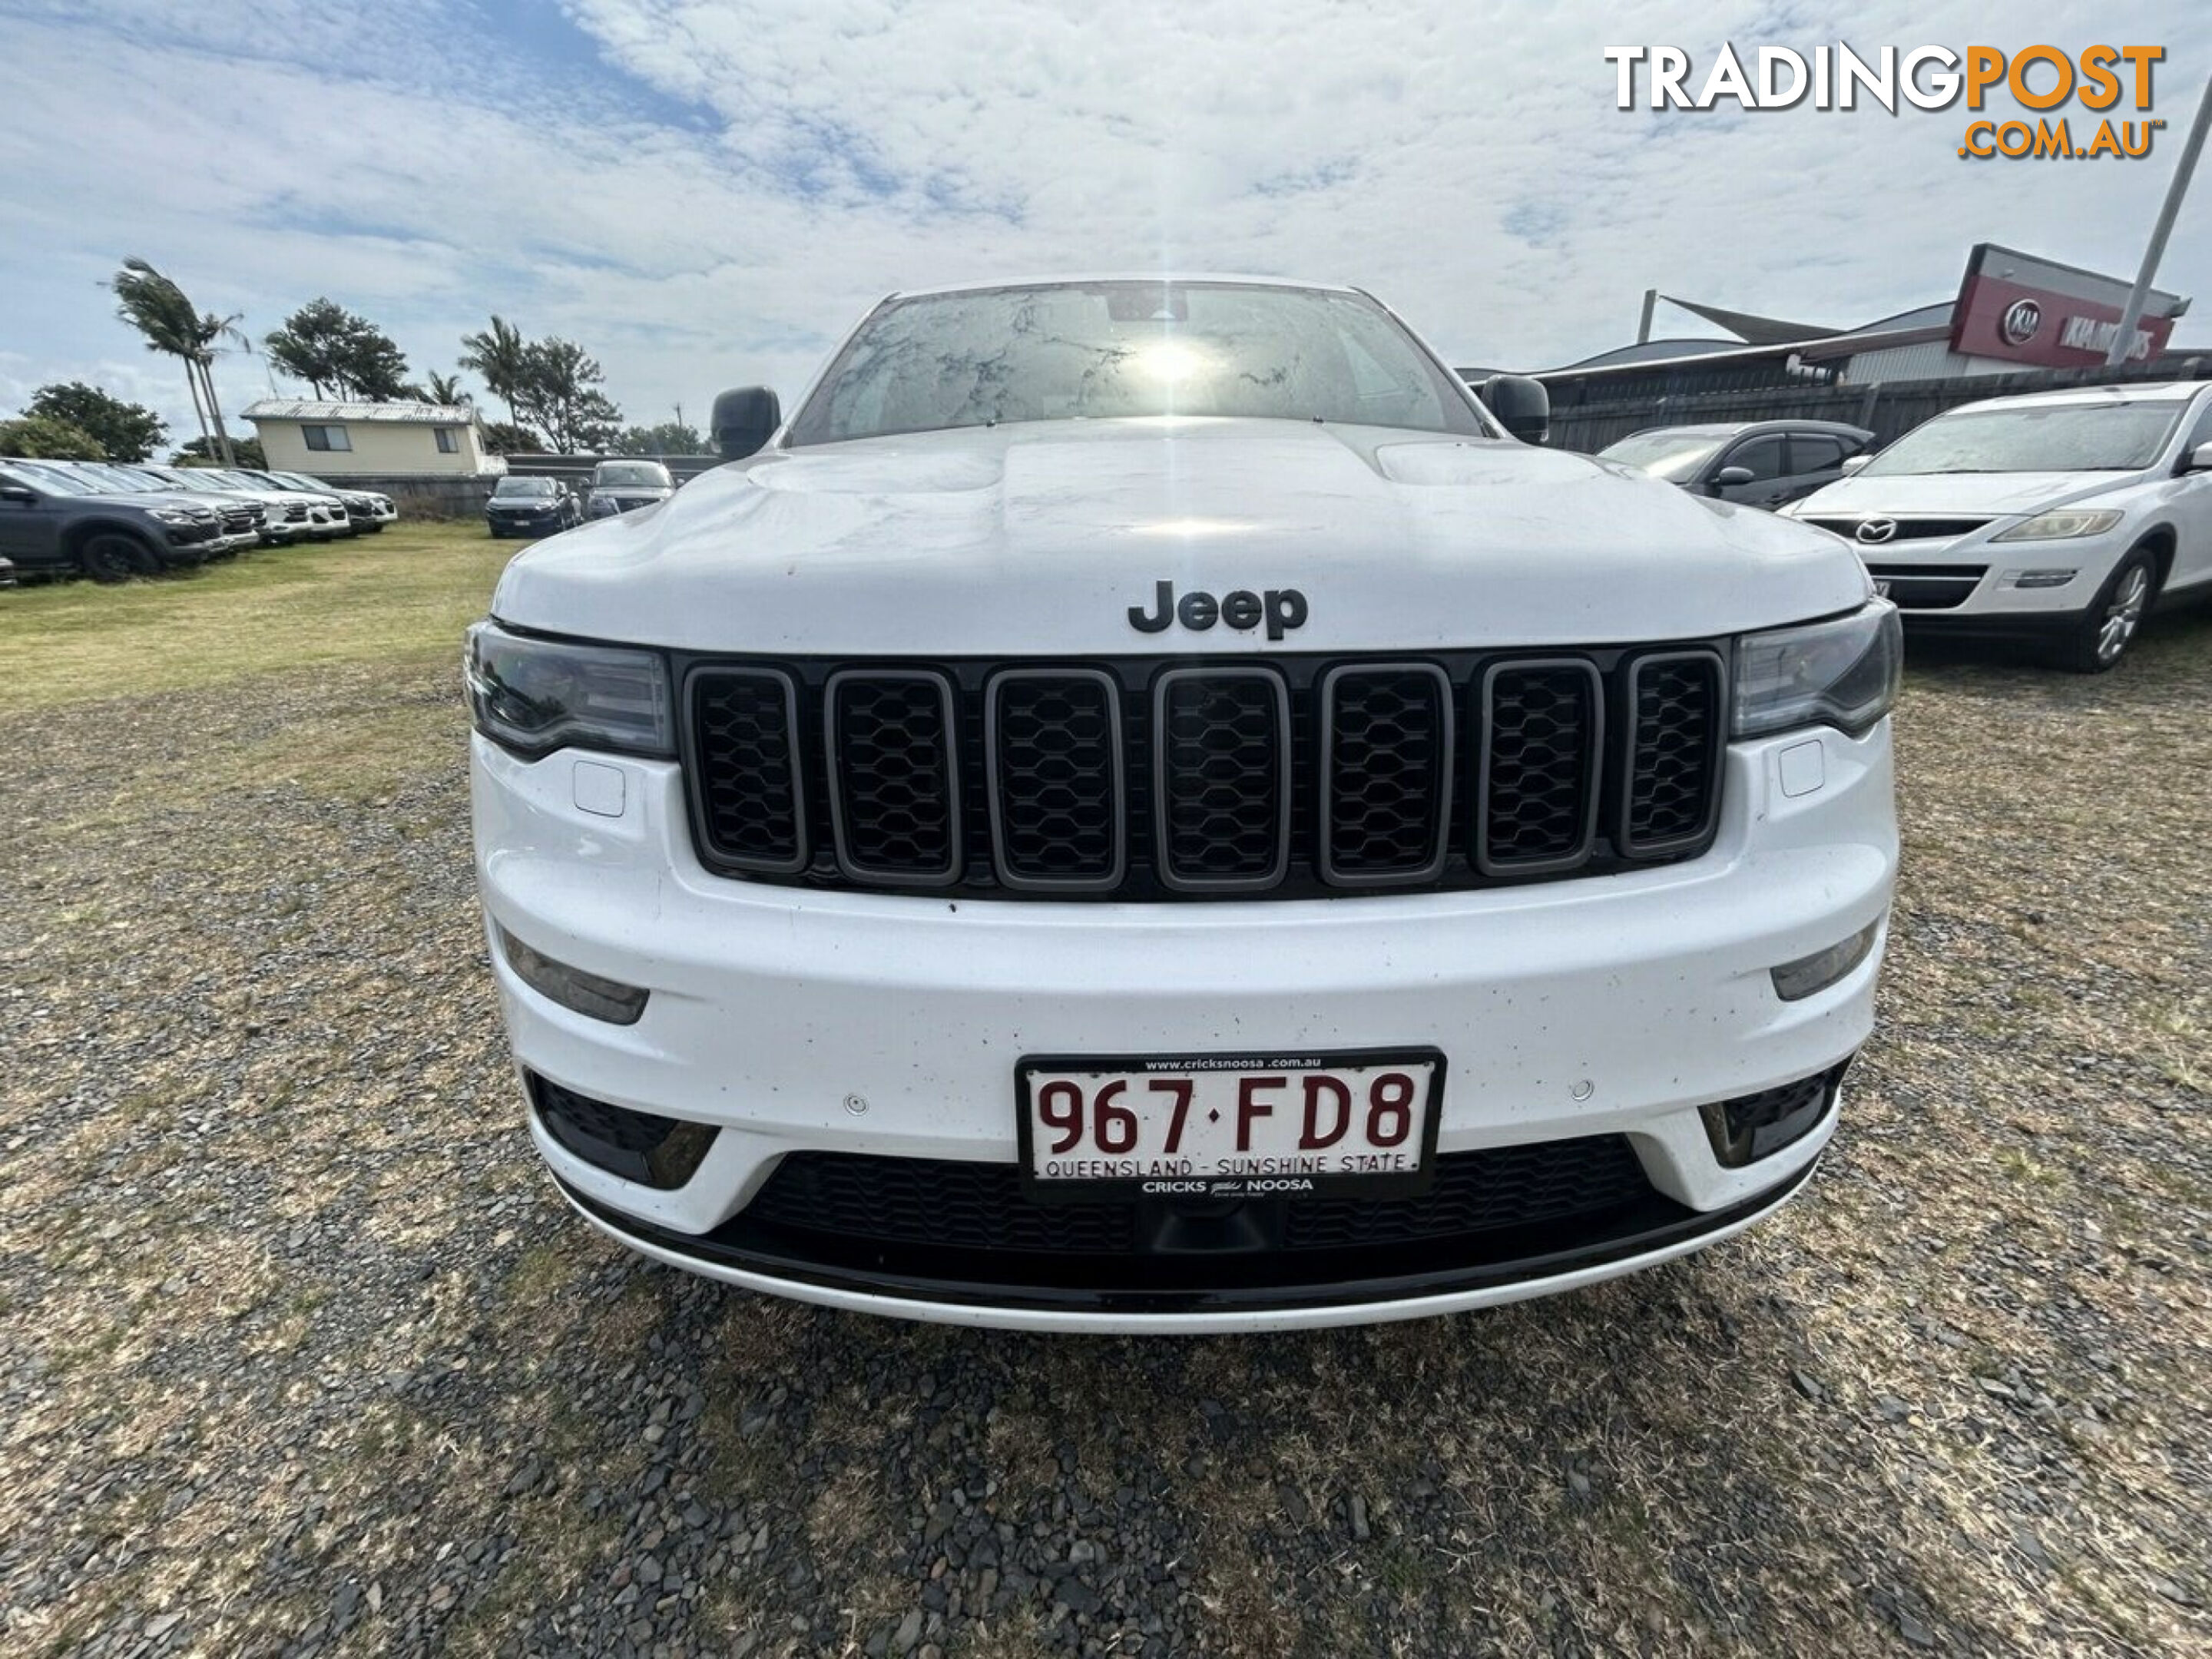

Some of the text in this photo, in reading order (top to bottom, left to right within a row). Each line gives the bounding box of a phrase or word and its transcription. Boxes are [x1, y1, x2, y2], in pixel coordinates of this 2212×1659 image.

[1128, 580, 1308, 641] Jeep
[1045, 1158, 1193, 1177] QUEENSLAND
[1217, 1154, 1328, 1174] SUNSHINE
[1340, 1153, 1406, 1173] STATE
[1141, 1181, 1207, 1193] CRICKS
[1246, 1178, 1314, 1191] NOOSA
